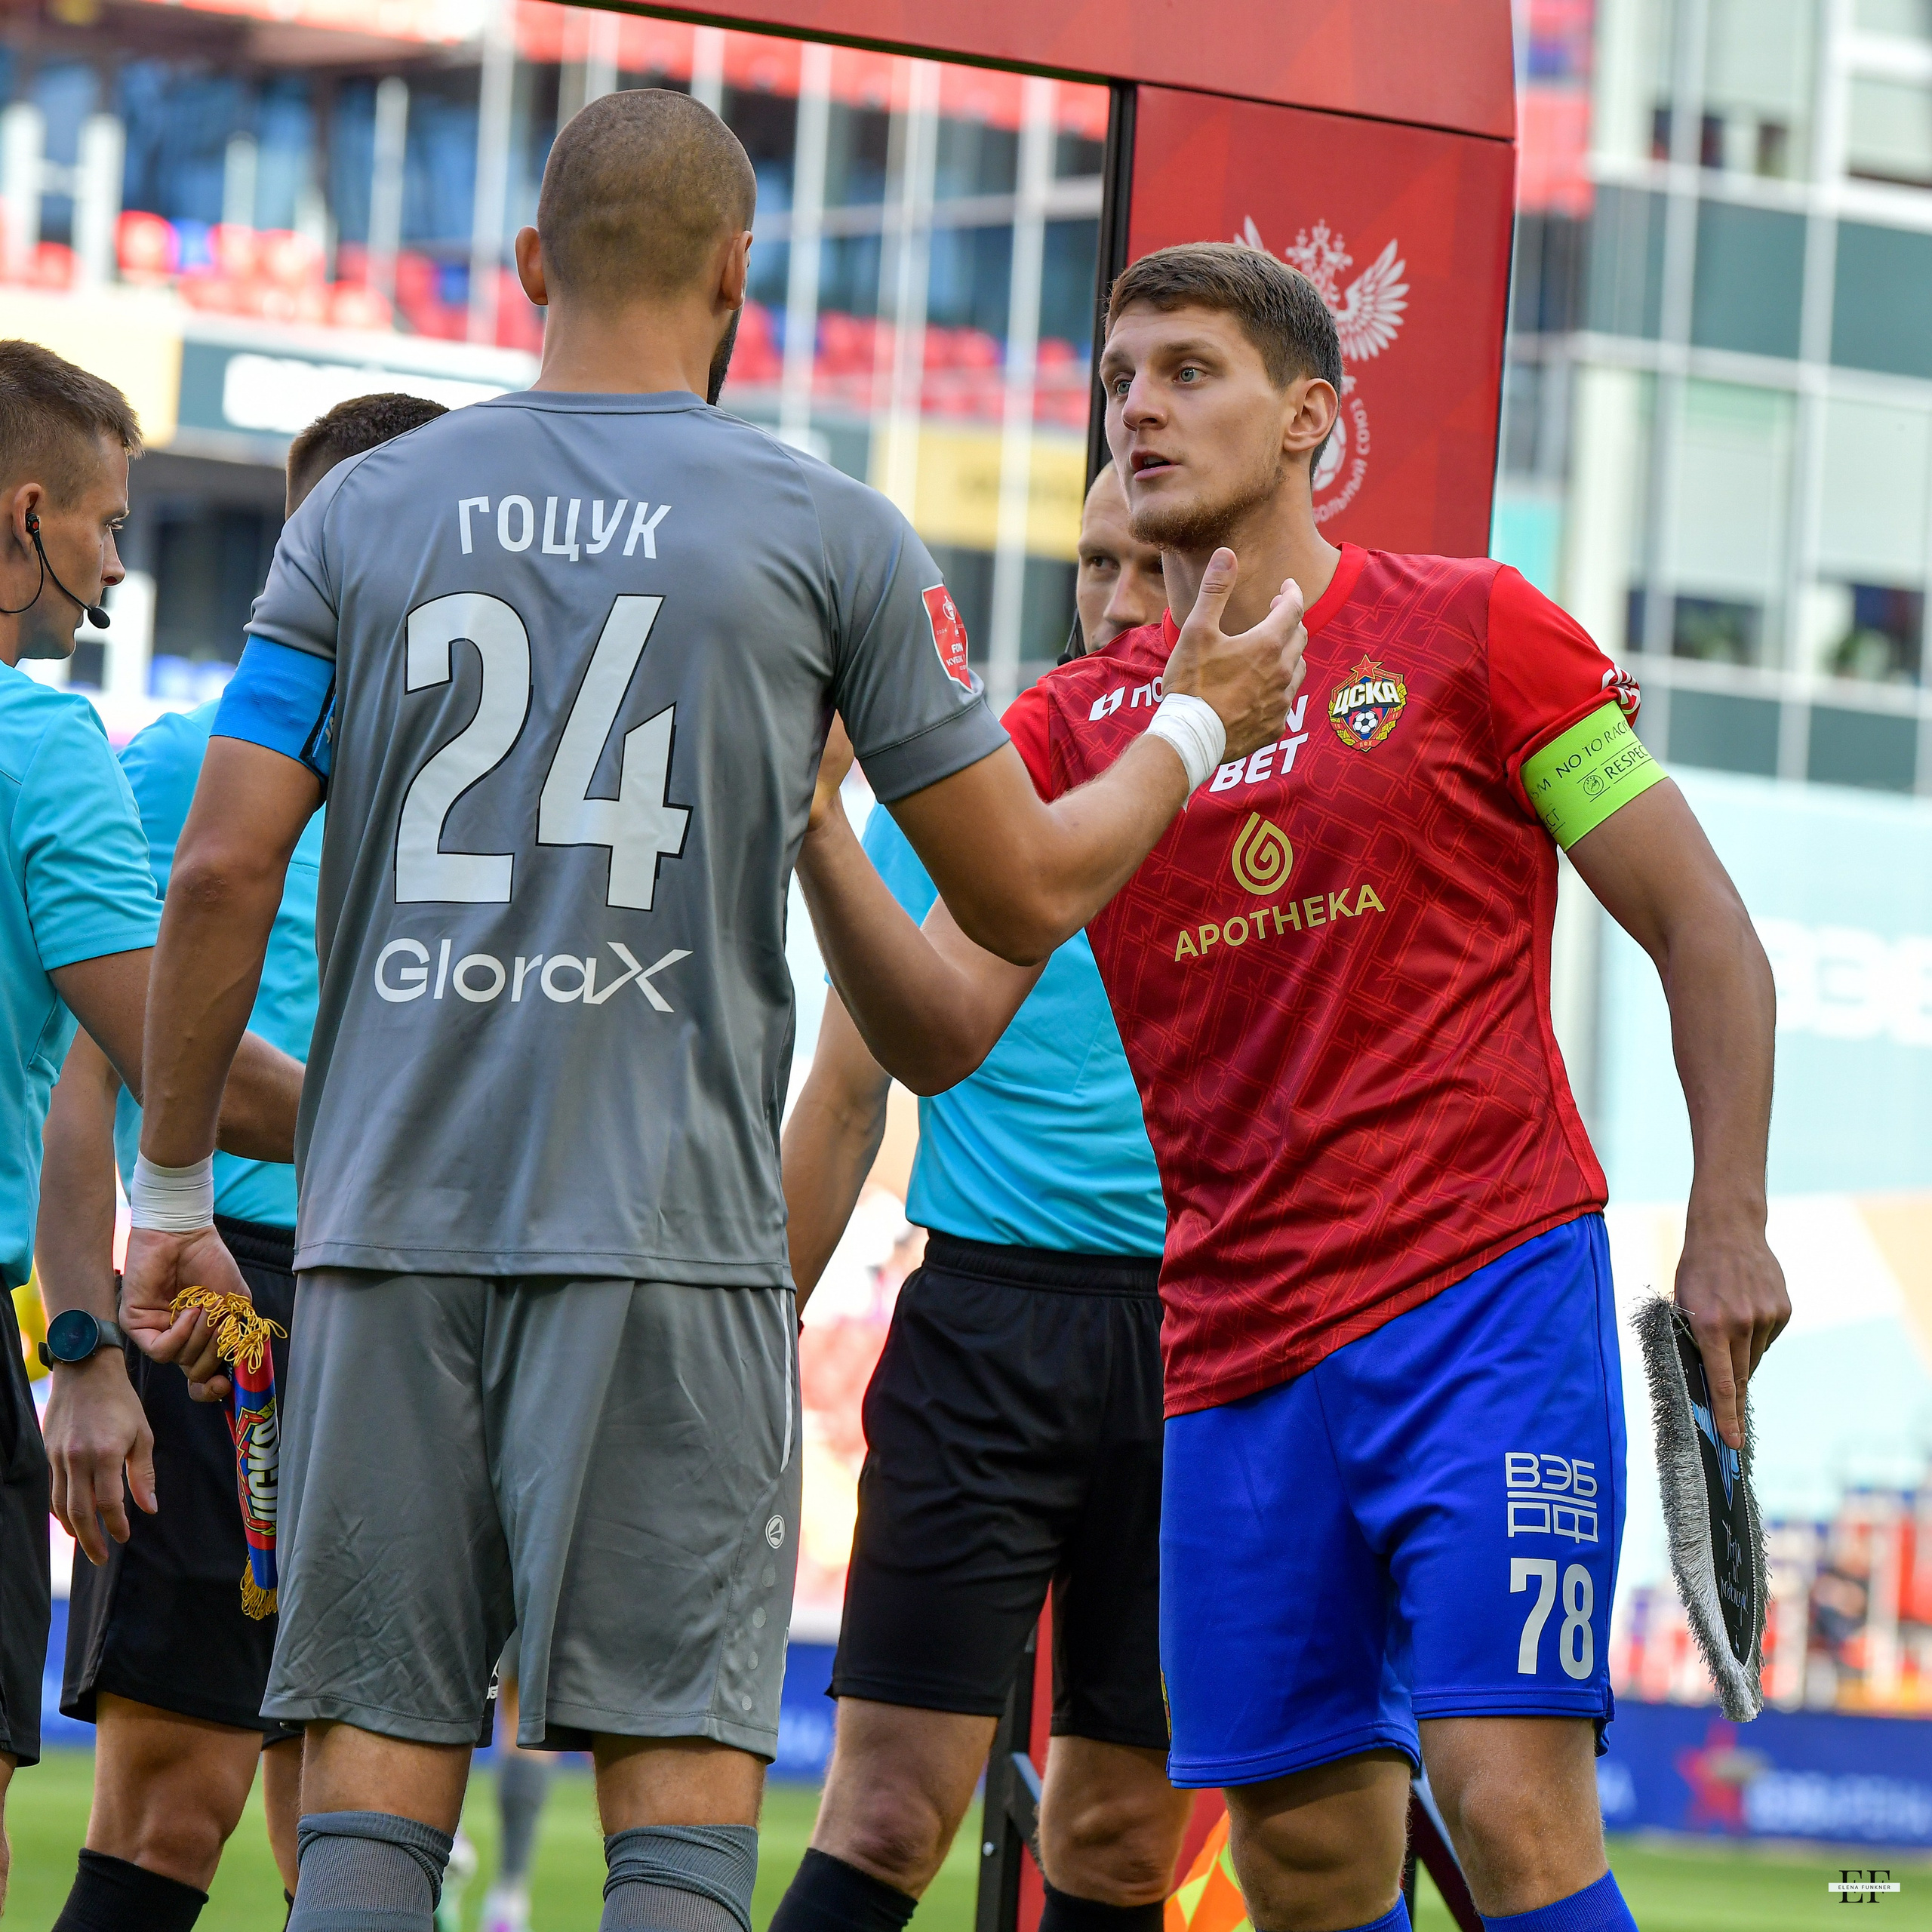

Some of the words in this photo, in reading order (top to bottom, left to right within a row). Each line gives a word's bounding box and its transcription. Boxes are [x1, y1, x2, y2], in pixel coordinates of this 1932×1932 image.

[458, 494, 672, 562] ГОЦУК
[1332, 681, 1402, 716] ЦСКА
[392, 591, 694, 912] 24
[1209, 733, 1309, 792] BET
[1555, 754, 1582, 779] NO
[1582, 738, 1603, 757] TO
[1604, 745, 1648, 780] RESPEC
[1174, 884, 1386, 962] APOTHEKA
[374, 937, 694, 1014] GloraX
[1505, 1452, 1598, 1497] ВЭБ
[1507, 1501, 1599, 1544] РФ
[1509, 1557, 1594, 1681] 78
